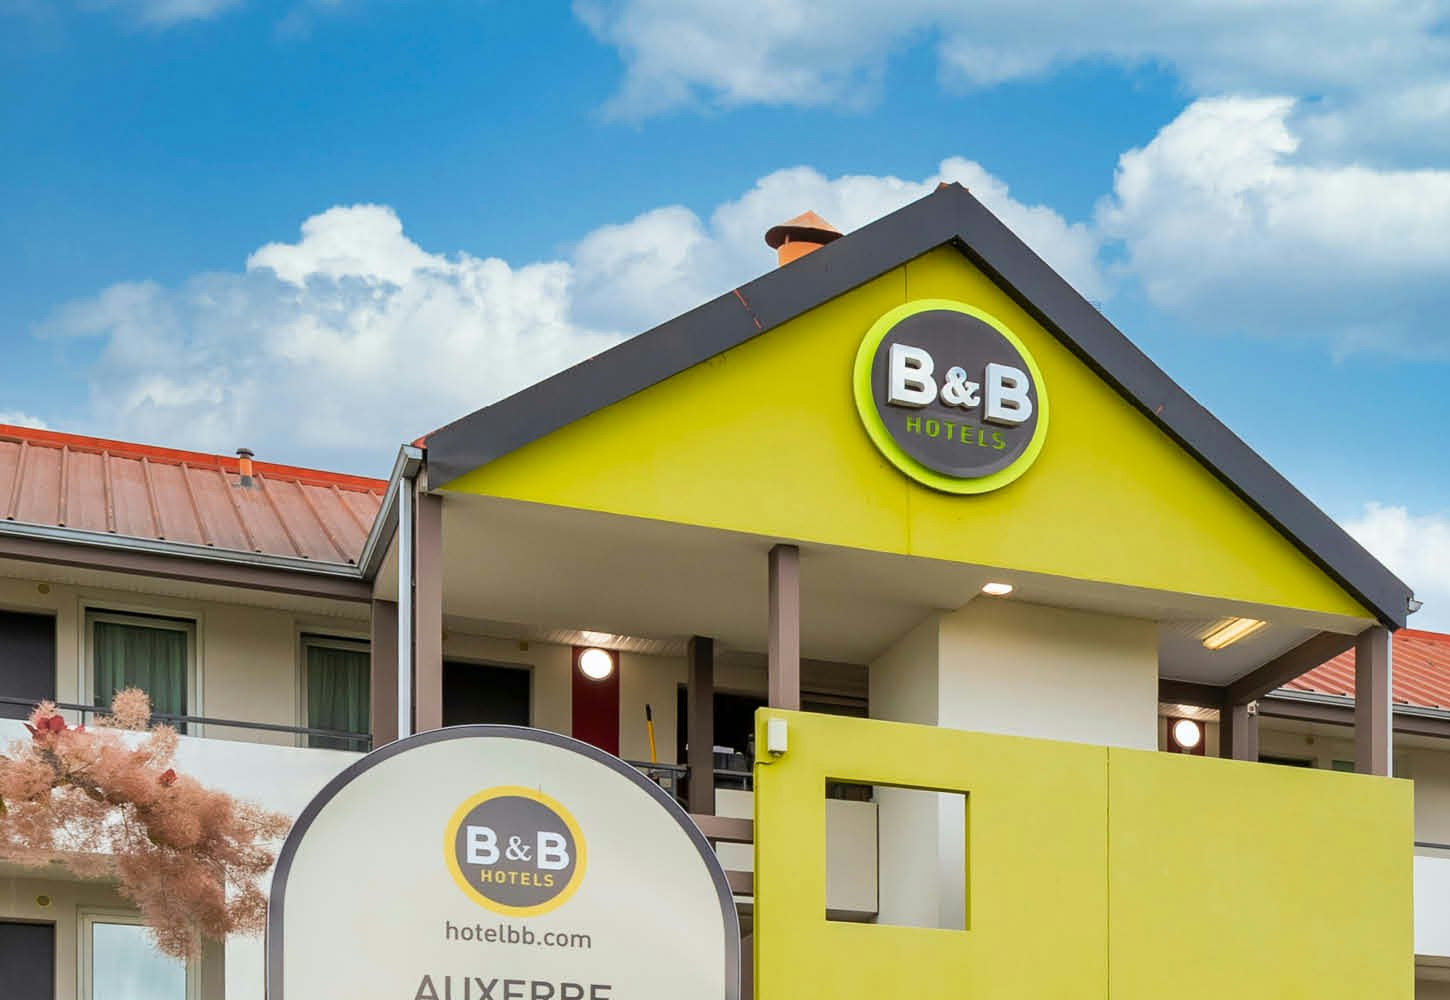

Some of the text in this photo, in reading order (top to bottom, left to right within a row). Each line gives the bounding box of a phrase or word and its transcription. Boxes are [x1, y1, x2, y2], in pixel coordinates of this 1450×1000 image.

[888, 343, 1033, 424] B&B
[906, 416, 1006, 450] HOTELS
[466, 825, 570, 870] B&B
[480, 870, 554, 887] HOTELS
[446, 921, 592, 949] hotelbb.com
